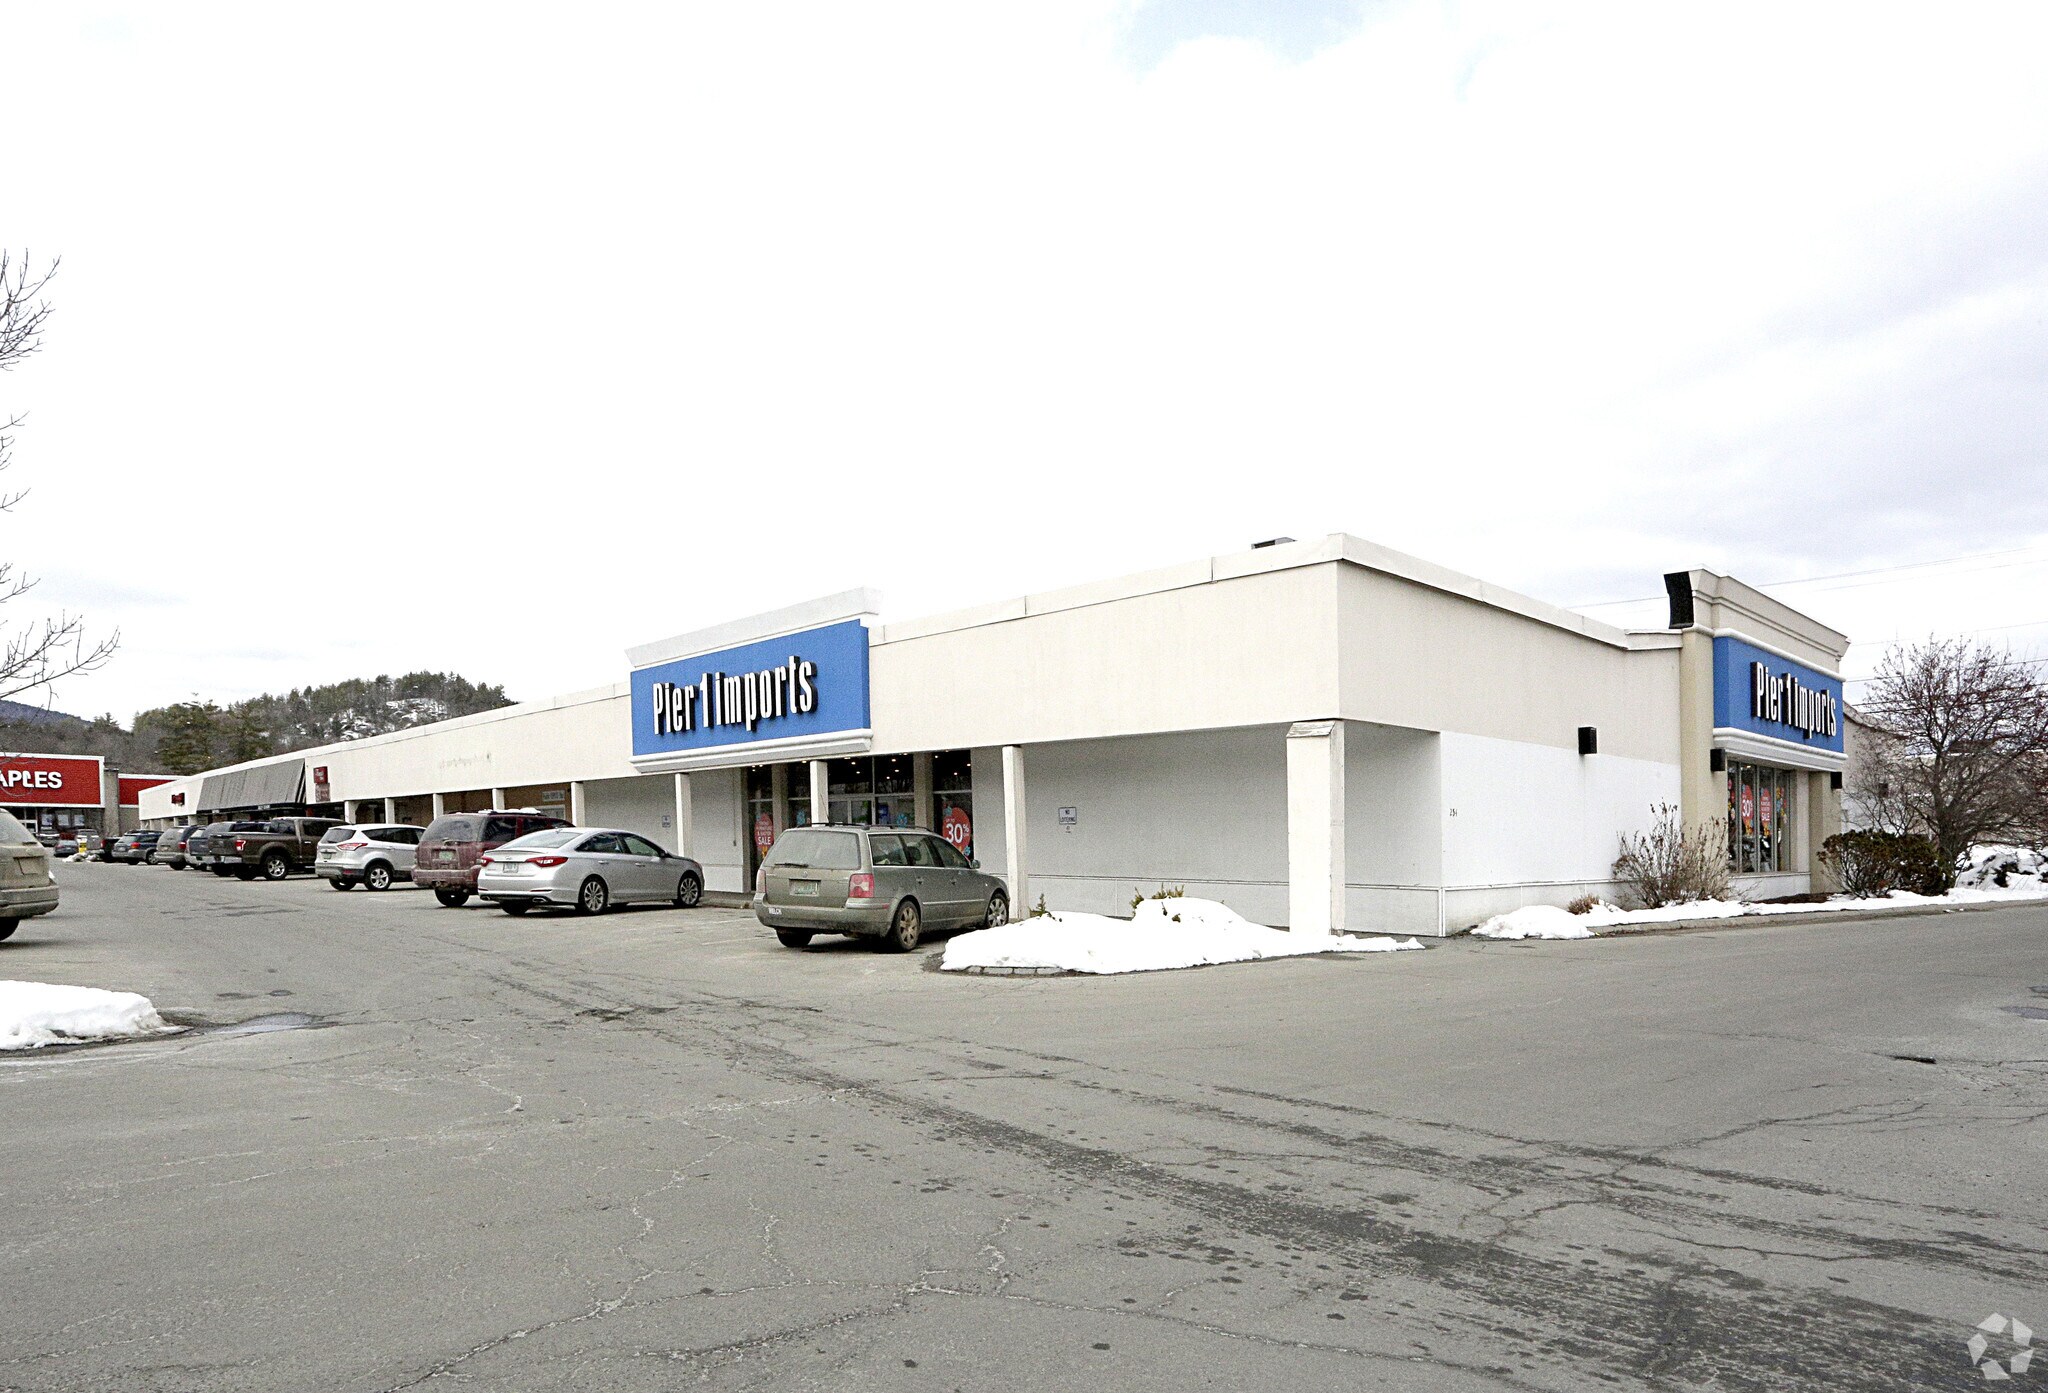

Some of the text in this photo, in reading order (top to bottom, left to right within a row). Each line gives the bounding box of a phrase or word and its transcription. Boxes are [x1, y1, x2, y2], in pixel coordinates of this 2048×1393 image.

[652, 655, 816, 735] Pier 1 imports
[1754, 661, 1783, 722] Pier
[1794, 676, 1837, 739] imports
[758, 836, 771, 845] SALE
